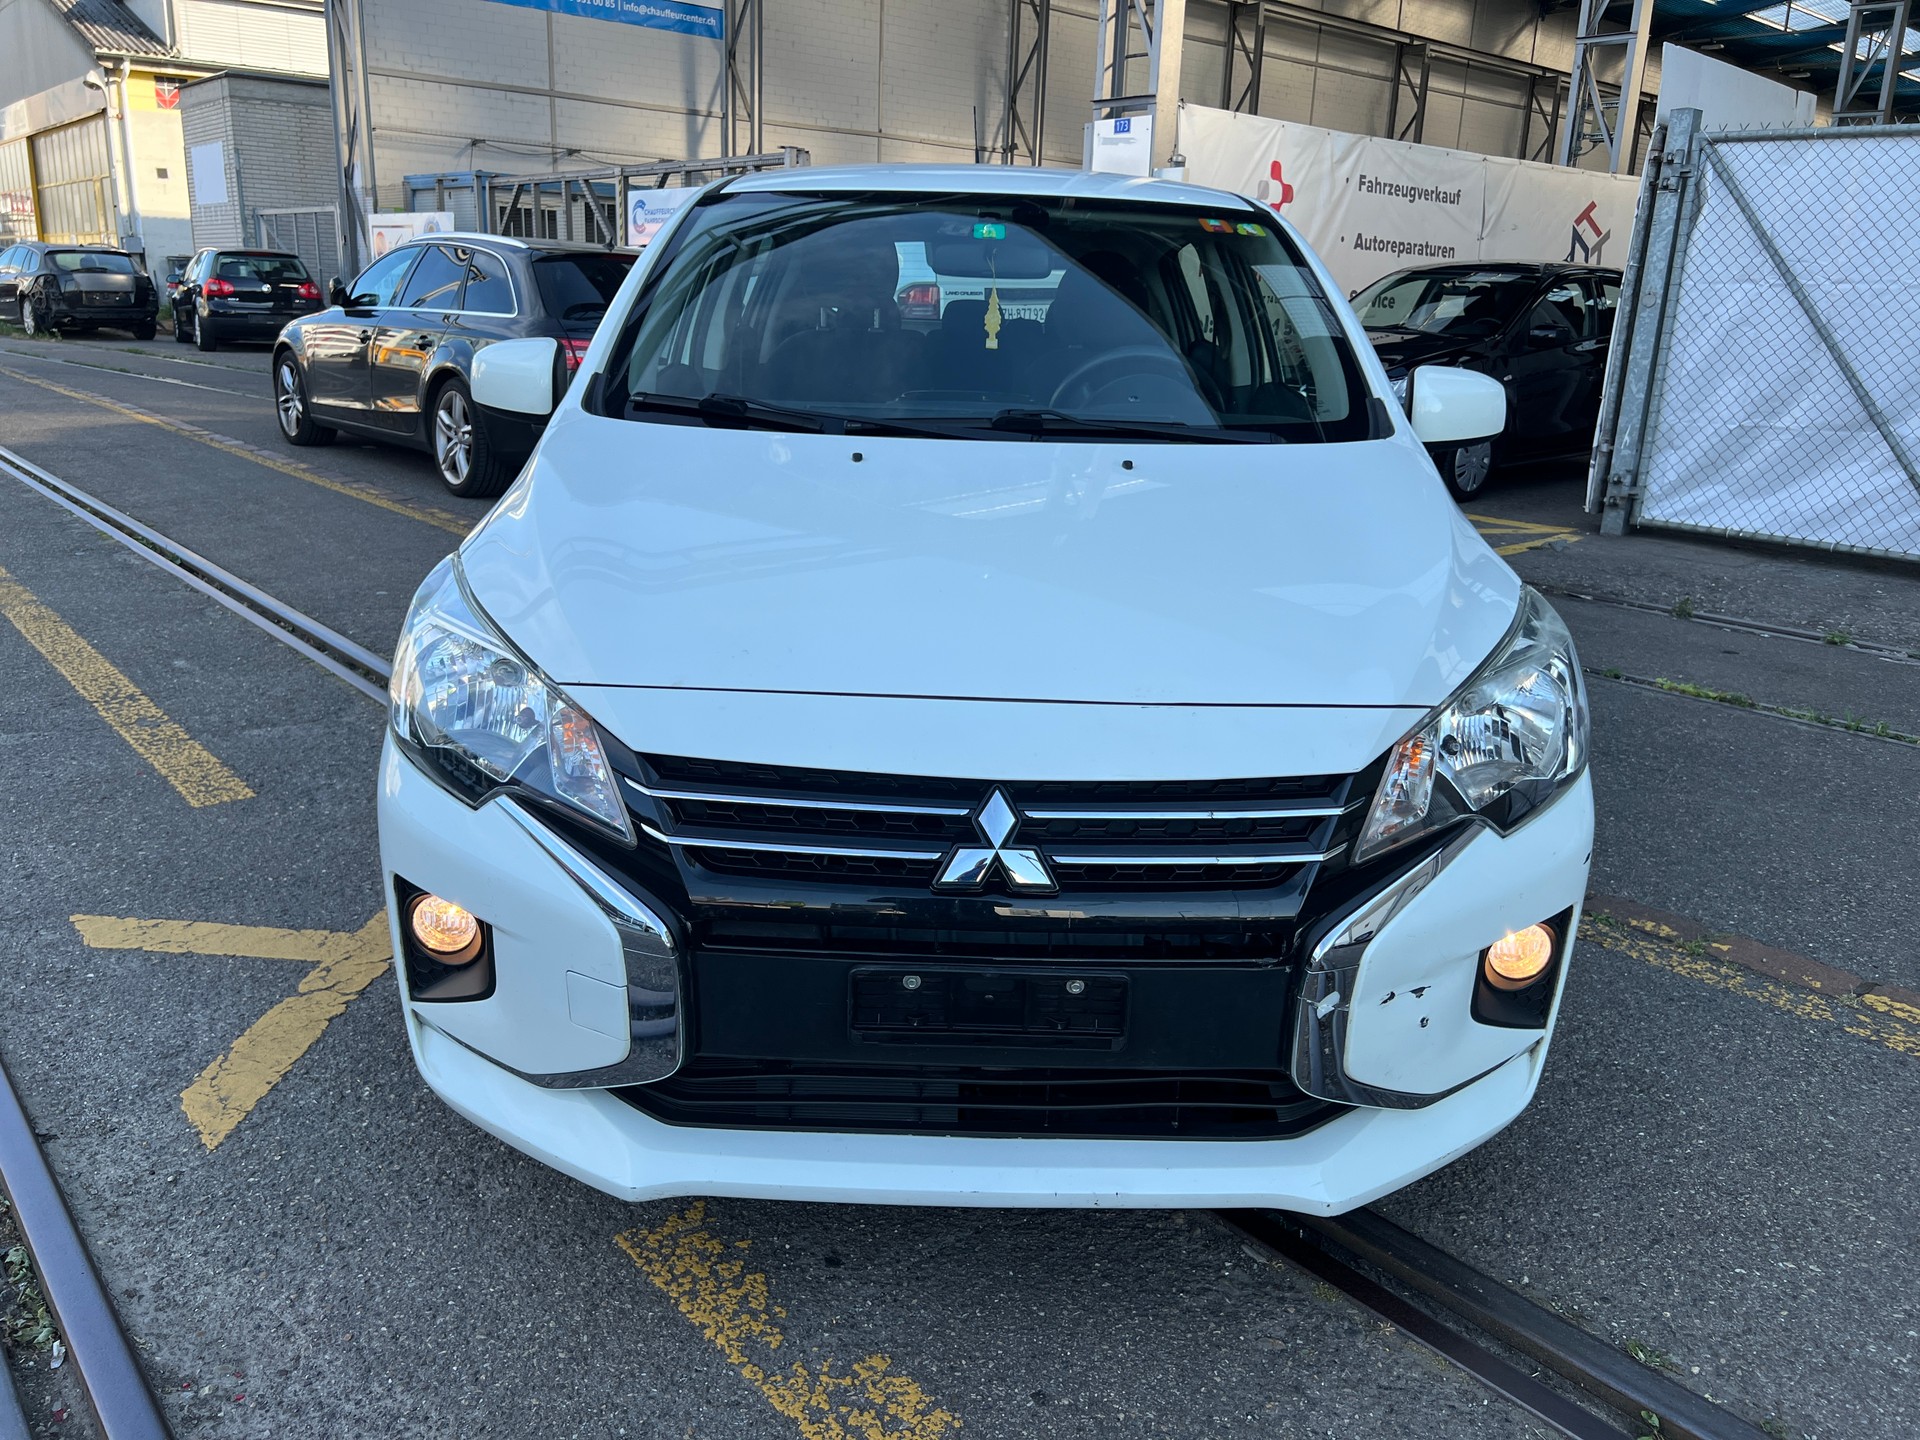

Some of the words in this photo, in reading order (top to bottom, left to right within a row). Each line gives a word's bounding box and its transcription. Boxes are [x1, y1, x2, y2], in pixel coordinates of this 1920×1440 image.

[623, 2, 716, 26] info@chauffeurcenter.ch
[1116, 120, 1129, 132] 173
[1358, 174, 1462, 206] Fahrzeugverkauf
[1353, 232, 1456, 259] Autoreparaturen
